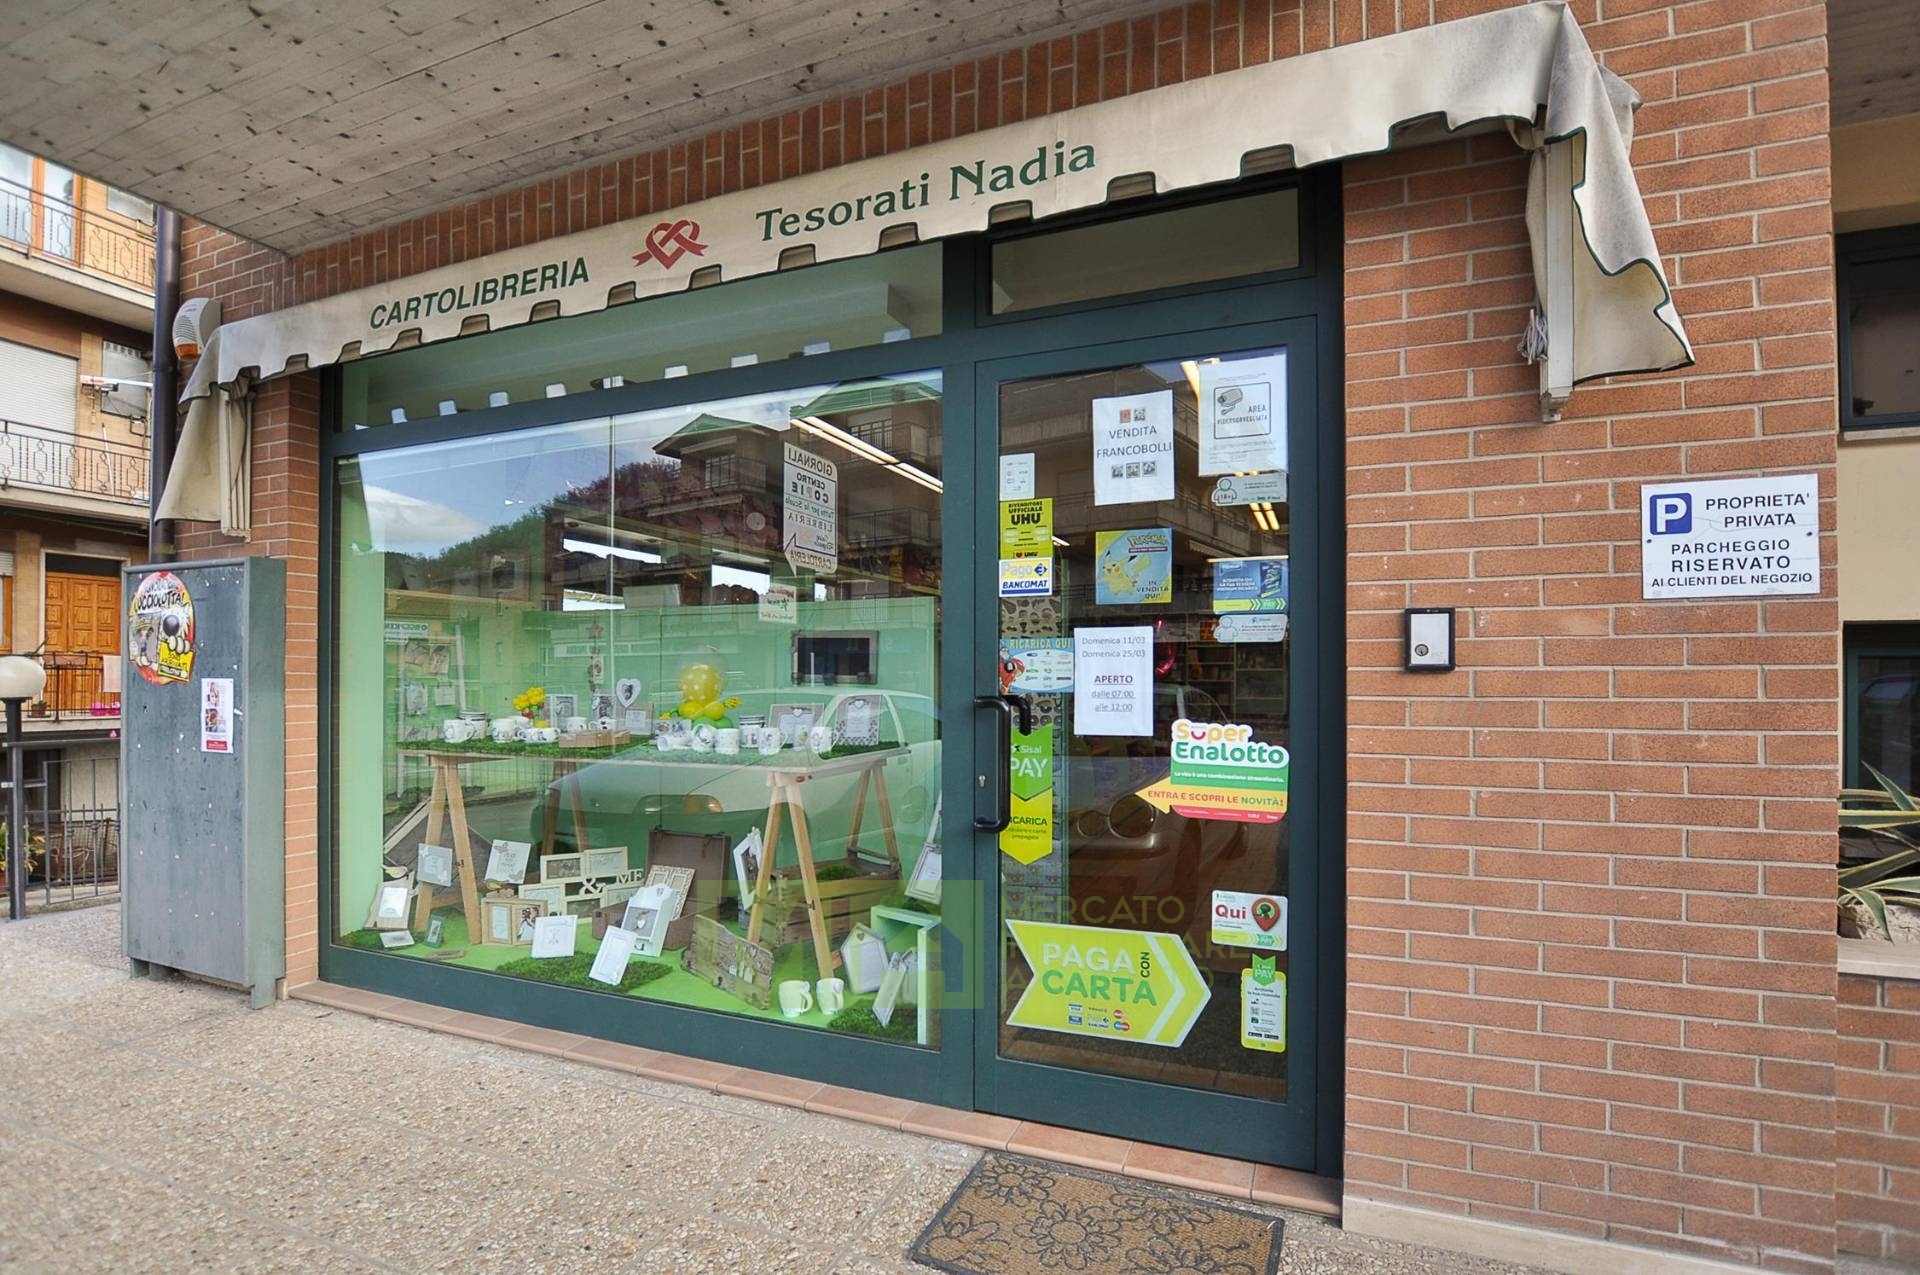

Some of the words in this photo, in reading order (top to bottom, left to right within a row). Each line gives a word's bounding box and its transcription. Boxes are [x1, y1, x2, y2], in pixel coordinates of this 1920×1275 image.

[756, 172, 930, 241] Tesorati
[949, 141, 1095, 200] Nadia
[370, 257, 589, 329] CARTOLIBRERIA
[1248, 404, 1267, 413] AREA
[1109, 425, 1157, 439] VENDITA
[1097, 442, 1171, 458] FRANCOBOLLI
[1008, 506, 1043, 514] UFFICIALE
[1656, 497, 1687, 532] P
[1011, 513, 1041, 525] UHU
[1724, 513, 1796, 528] PRIVATA
[1672, 539, 1790, 555] PARCHEGGIO
[1002, 562, 1033, 579] Pago
[1672, 556, 1790, 572] RISERVATO
[1002, 580, 1048, 589] BANCOMAT
[1652, 578, 1663, 587] AI
[1668, 576, 1717, 586] CLIENTI
[1721, 575, 1746, 585] DEL
[1751, 573, 1812, 584] NEGOZIO
[1010, 639, 1052, 648] RICARICA
[1056, 639, 1071, 648] QUI
[1082, 637, 1120, 645] Domenica
[1123, 636, 1146, 645] 11/03
[1082, 650, 1120, 658] Domenica
[1122, 650, 1146, 658] 25/03
[1094, 675, 1133, 684] APERTO
[1091, 690, 1110, 698] dalle
[1095, 704, 1110, 712] alle
[1111, 704, 1133, 712] 12:00
[1175, 742, 1285, 764] Enalotto
[1010, 758, 1048, 778] PAY
[1148, 790, 1178, 800] ENTRA
[1189, 794, 1225, 803] SCOPRI
[1227, 796, 1239, 804] LE
[1215, 904, 1246, 920] Qui
[1042, 942, 1137, 976] PAGA
[1140, 951, 1151, 979] CON
[1255, 969, 1275, 979] PAY
[1042, 969, 1158, 1006] CARTA
